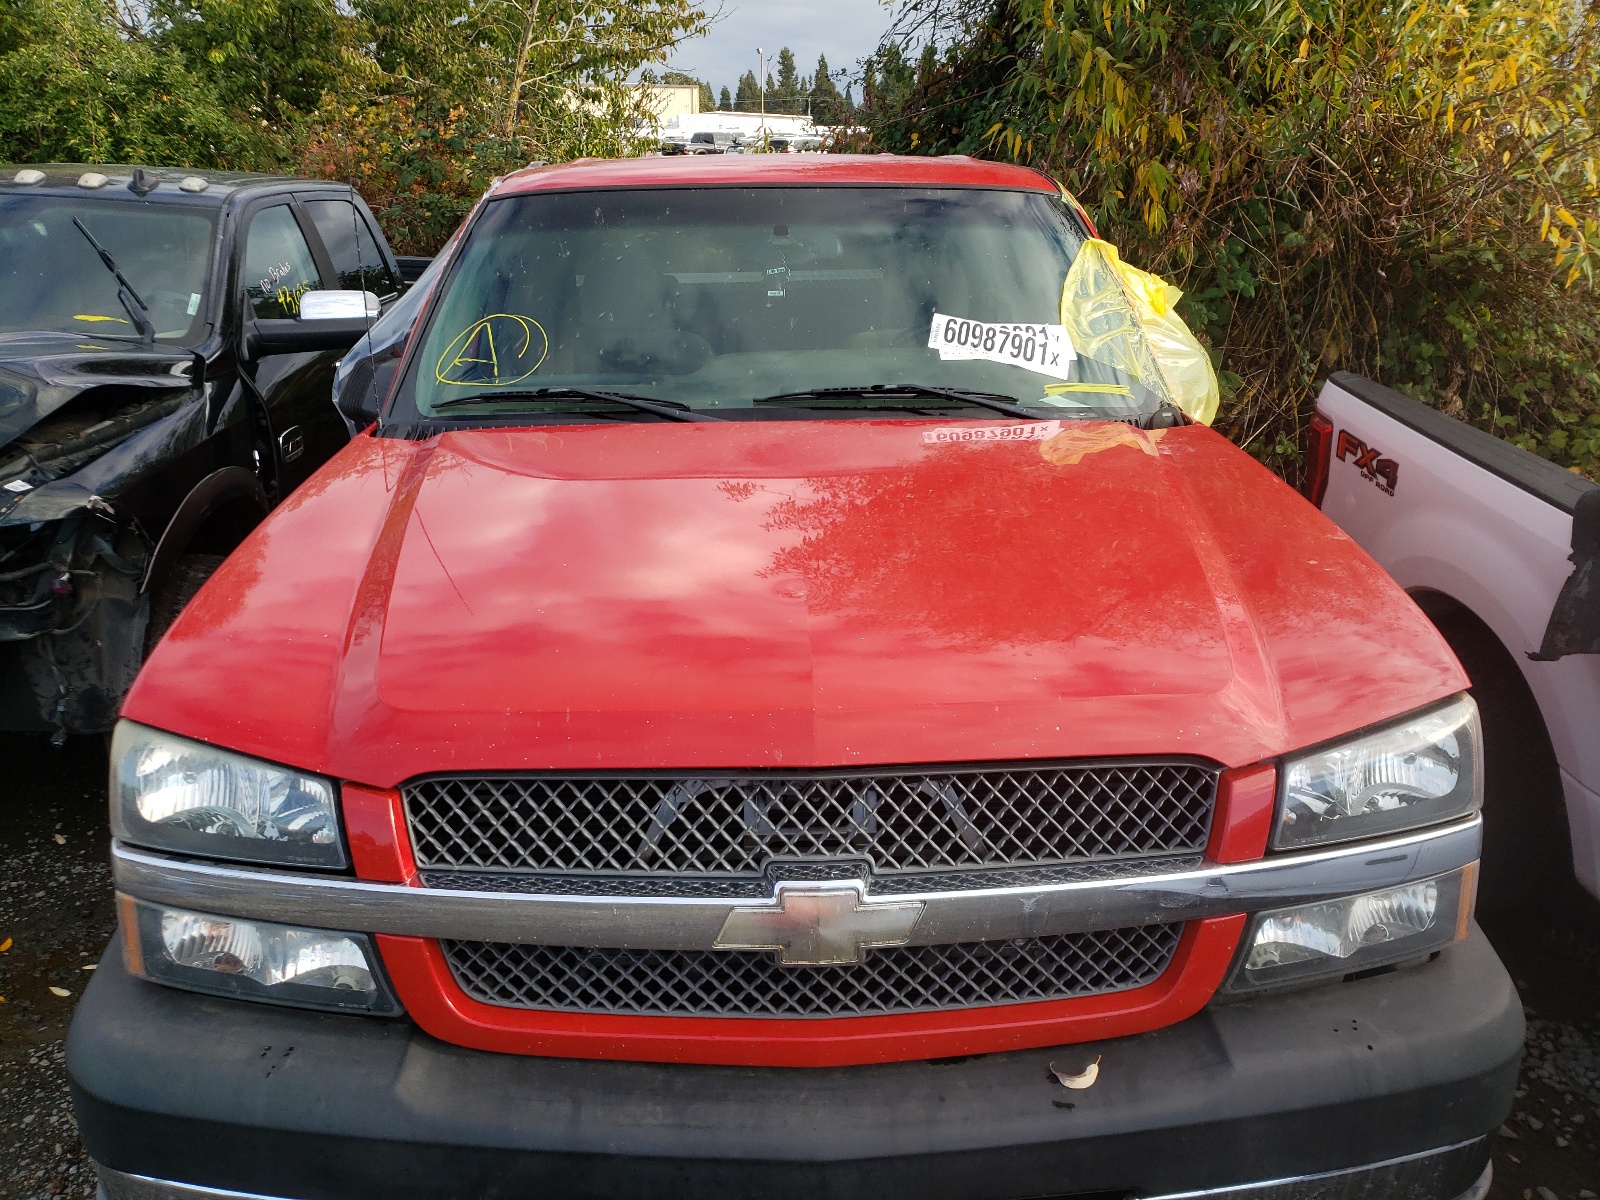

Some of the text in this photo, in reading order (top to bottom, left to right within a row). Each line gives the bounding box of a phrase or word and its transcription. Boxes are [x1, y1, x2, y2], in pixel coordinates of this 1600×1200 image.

[943, 318, 1048, 366] 60987901
[1336, 428, 1400, 492] FX4
[1360, 470, 1395, 497] OFF ROAD
